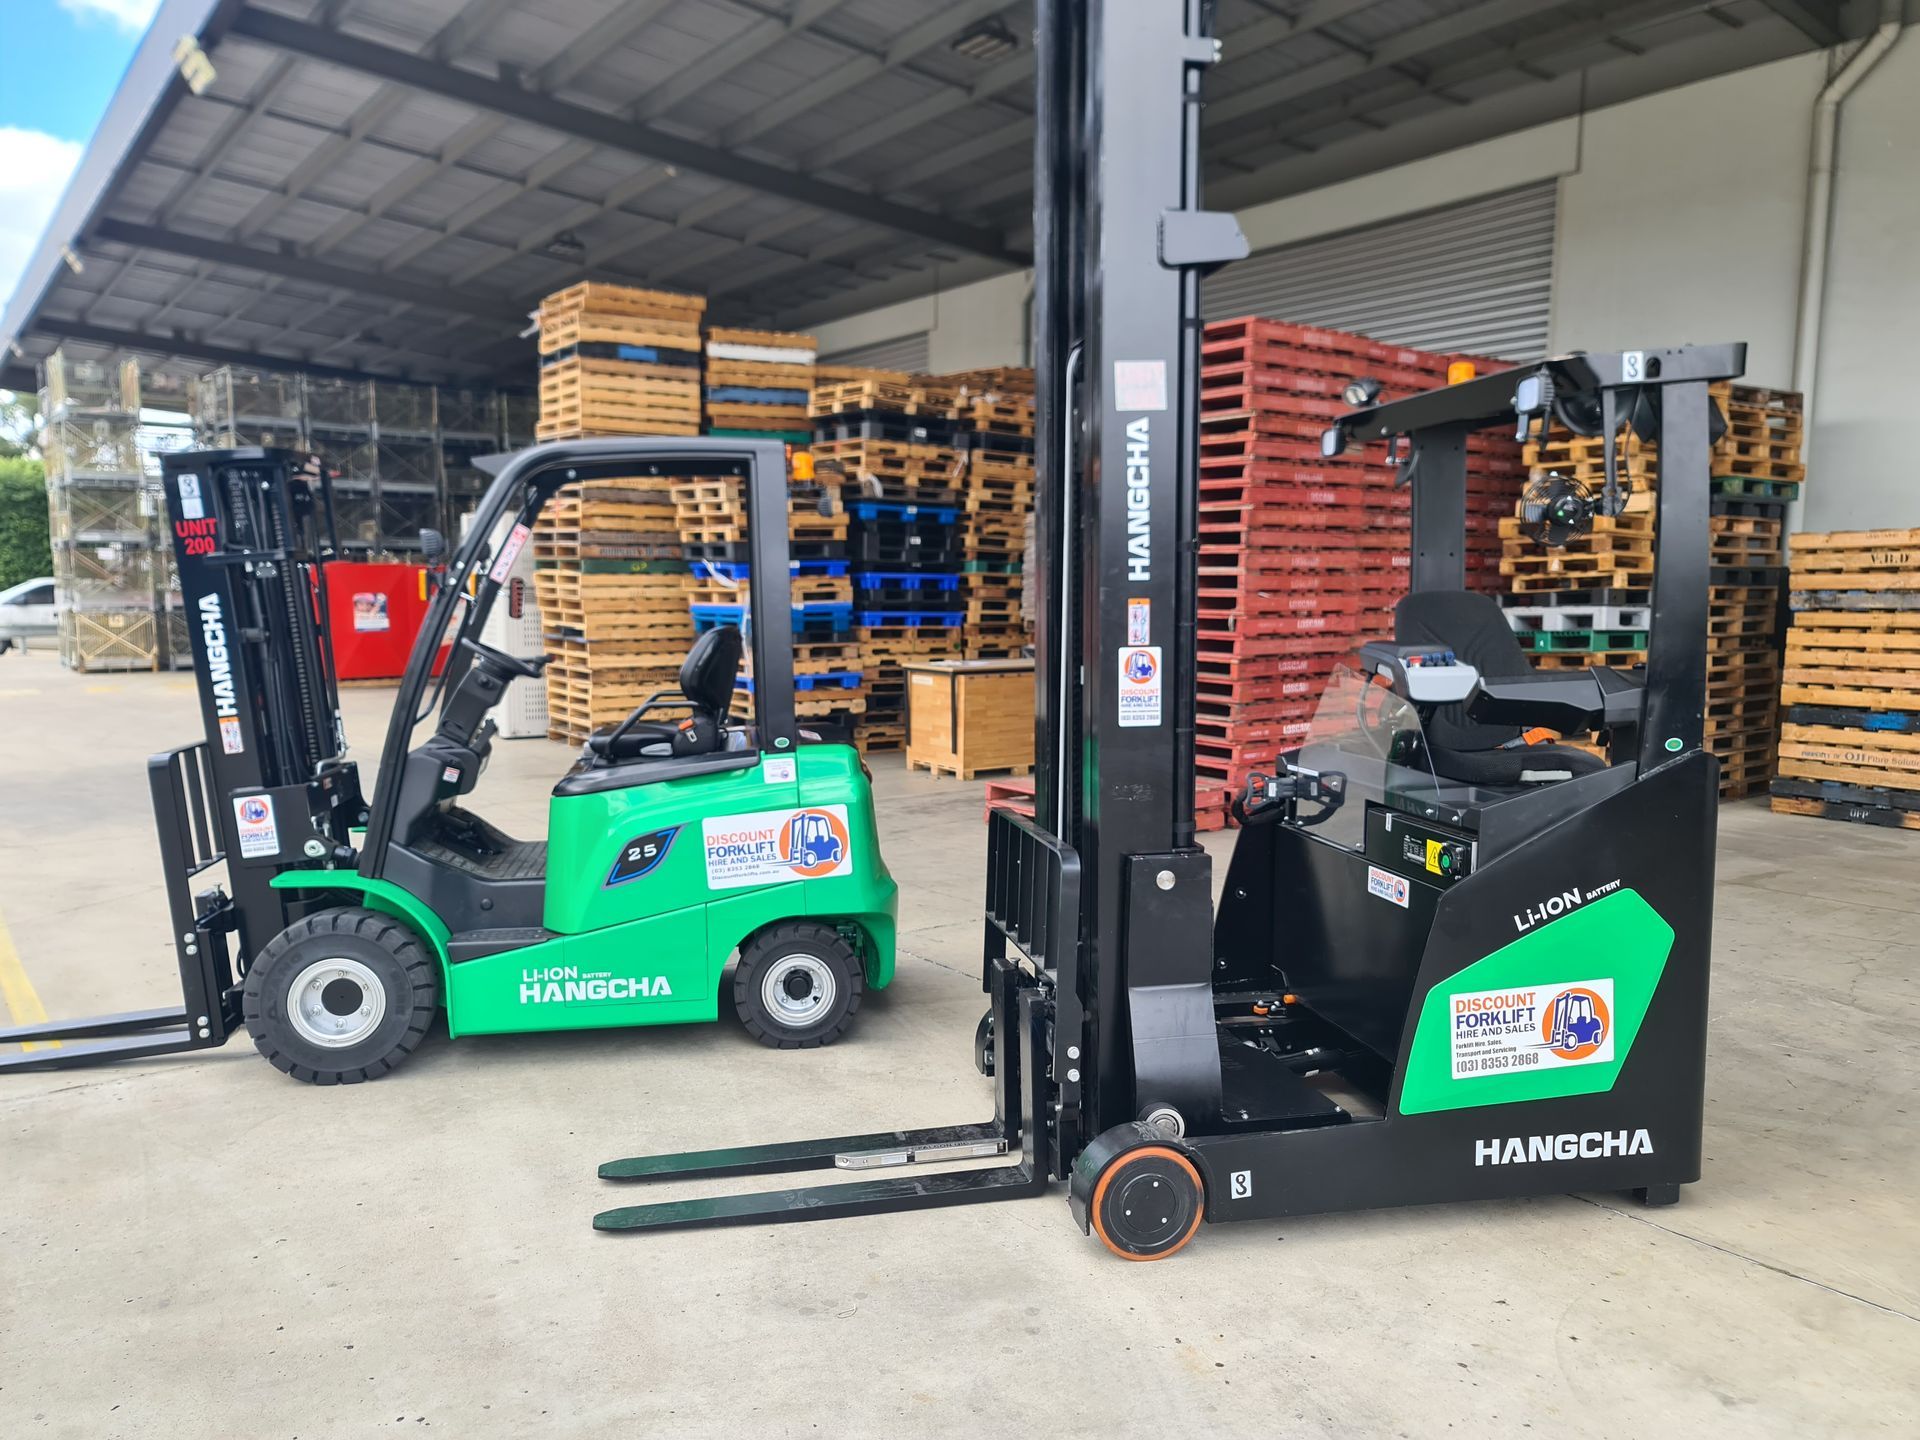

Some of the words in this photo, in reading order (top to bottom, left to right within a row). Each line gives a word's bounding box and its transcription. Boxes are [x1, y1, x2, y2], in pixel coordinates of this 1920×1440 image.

[1126, 416, 1151, 581] HANGCHA
[176, 517, 217, 538] UNIT
[184, 536, 215, 555] 200
[199, 592, 238, 717] HANGCHA
[1120, 688, 1159, 696] DISCOUNT
[1120, 695, 1159, 703] FORKLIFT
[706, 829, 775, 846] DISCOUNT
[628, 843, 657, 861] 25
[708, 841, 775, 859] FORKLIFT
[708, 858, 728, 867] HIRE
[730, 856, 749, 865] AND
[750, 853, 777, 862] SALES
[1371, 868, 1394, 884] DISCOUNT
[1371, 876, 1394, 893] FORKLIFT
[1514, 887, 1582, 932] Li-ION
[1586, 879, 1621, 900] BATTERY
[522, 966, 577, 982] LI-ION
[582, 971, 612, 979] BATTERY
[520, 976, 672, 1004] HANGCHA
[1455, 992, 1536, 1013] DISCOUNT
[1456, 1007, 1536, 1029] FORKLIFT
[1456, 1029, 1479, 1040] HIRE
[1481, 1026, 1503, 1037] AND
[1505, 1023, 1536, 1034] SALES
[1456, 1050, 1481, 1058] Transport
[1492, 1046, 1517, 1054] Servicing
[1456, 1060, 1478, 1073] (03)
[1481, 1055, 1509, 1070] 8353
[1511, 1052, 1539, 1066] 2868
[1475, 1129, 1654, 1166] HANGCHA
